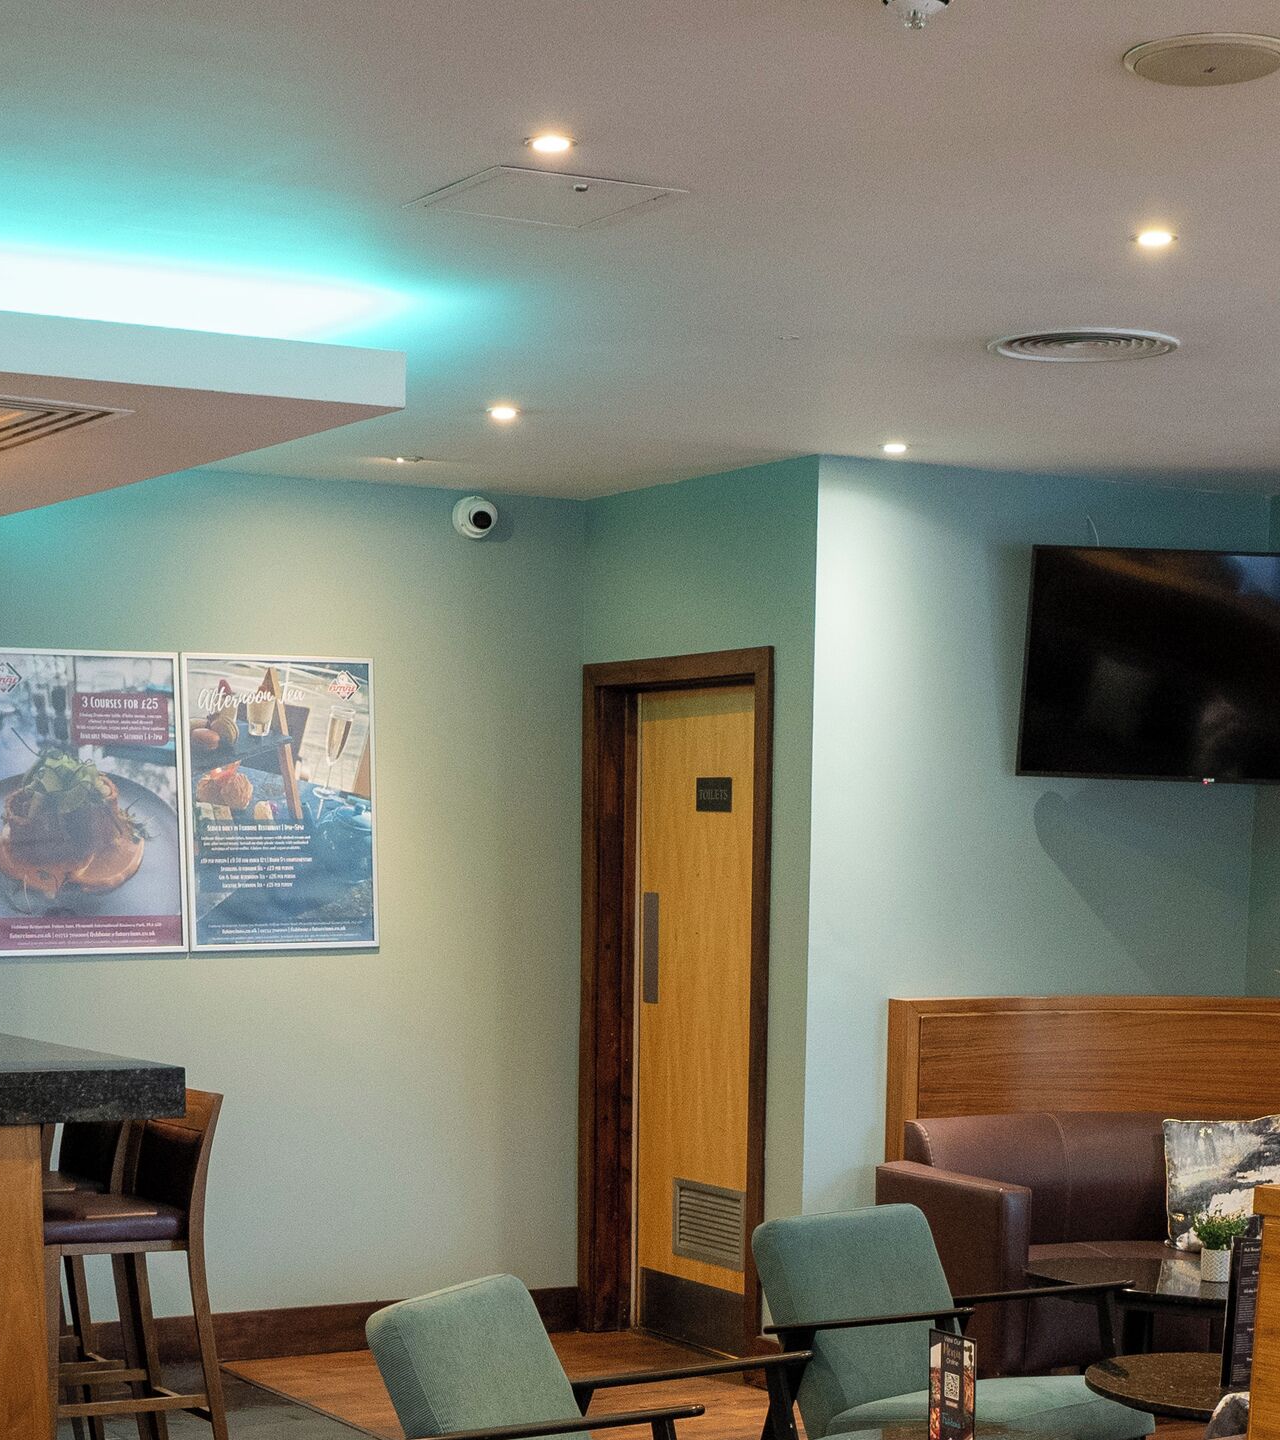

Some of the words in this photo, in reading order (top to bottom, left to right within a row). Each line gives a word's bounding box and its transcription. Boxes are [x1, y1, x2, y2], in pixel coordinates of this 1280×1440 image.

[81, 695, 88, 708] 3
[90, 696, 121, 709] COURSES
[124, 699, 138, 709] FOR
[141, 698, 159, 709] £25
[197, 686, 276, 713] Afternoon
[278, 681, 305, 704] Tea
[699, 789, 728, 800] TOILETS
